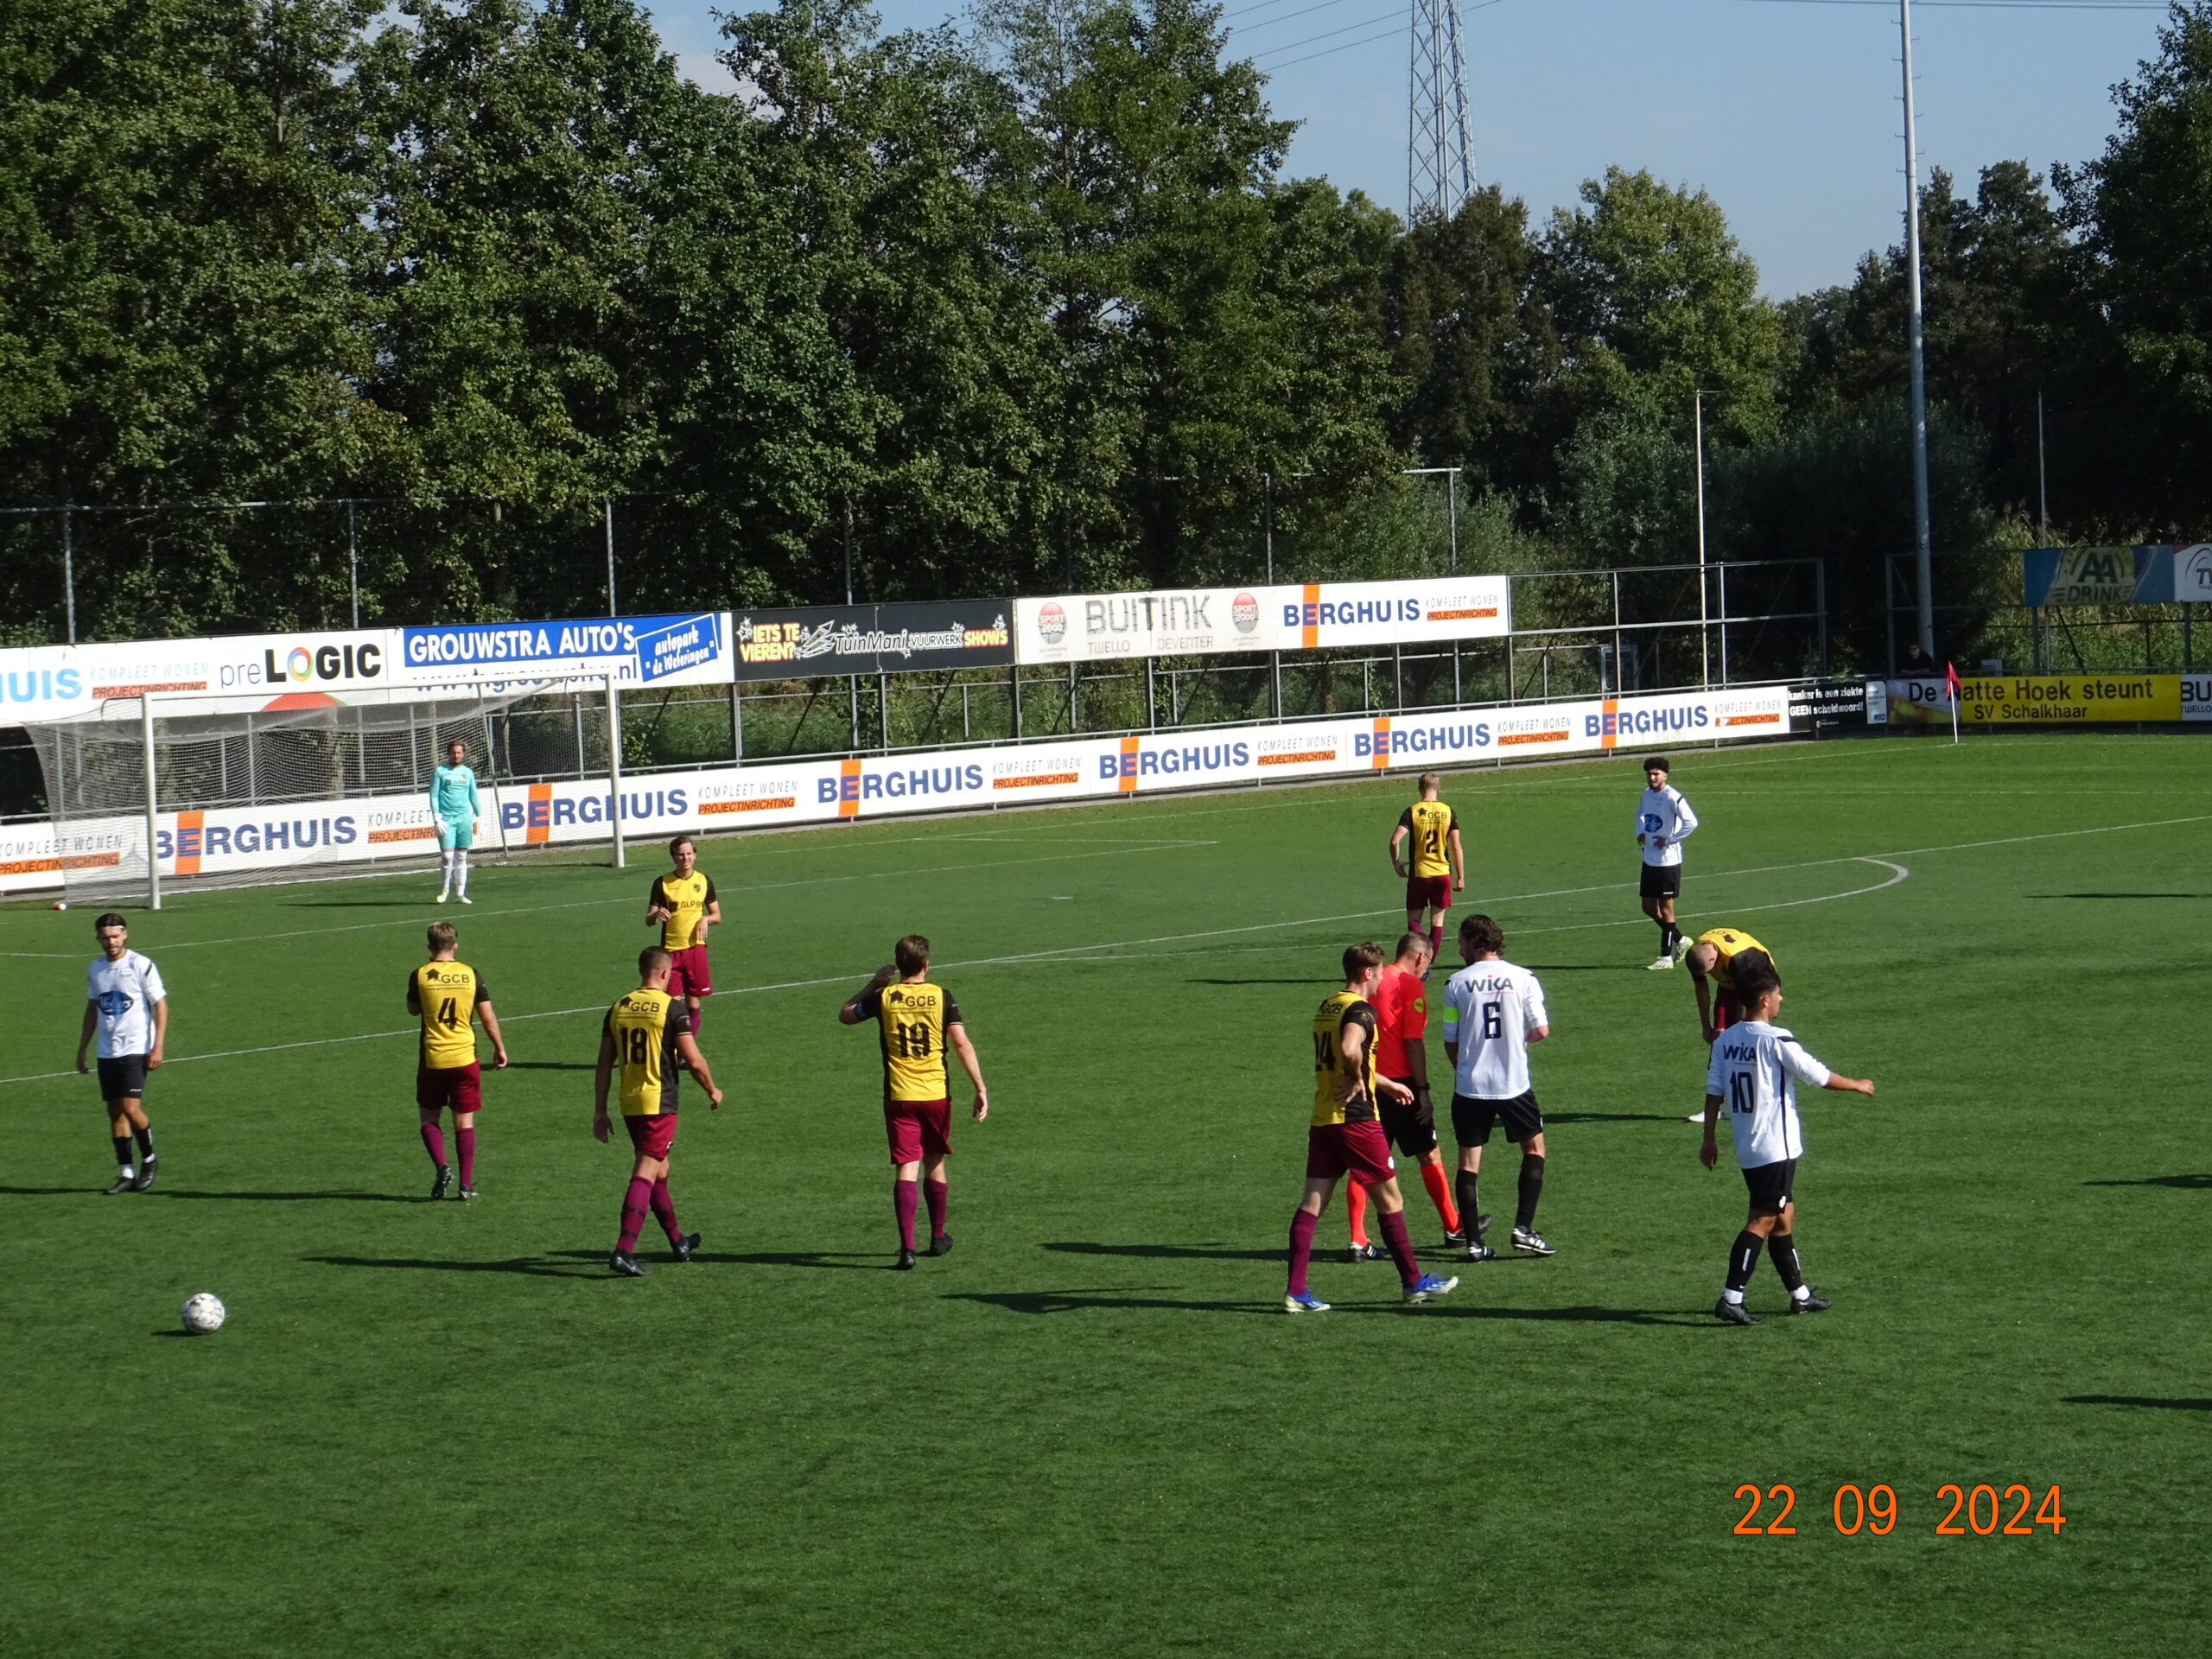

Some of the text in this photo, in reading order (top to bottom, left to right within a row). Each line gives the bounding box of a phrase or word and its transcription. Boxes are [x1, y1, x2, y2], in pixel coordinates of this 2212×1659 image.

[2076, 552, 2117, 583] AA
[1427, 594, 1498, 607] KOMPLEET WONEN
[2067, 585, 2122, 602] DRINK
[1085, 594, 1212, 635] BUITINK
[1233, 604, 1257, 614] SPORT
[1236, 613, 1256, 622] 2000
[1283, 598, 1421, 627] BERGHUIS
[1427, 607, 1497, 621] PROJECTINRICHTING
[1039, 613, 1065, 624] SPORT
[1041, 622, 1064, 632] 2000
[655, 624, 699, 656] autopark
[753, 622, 800, 644] IETS TE
[836, 629, 1008, 654] TuinMani VUURWERK SHOWS
[410, 622, 635, 663] GROUWSTRA AUTO'S
[1087, 639, 1130, 654] TWELLO
[1158, 636, 1214, 650] DEVENTER
[739, 641, 796, 663] VIEREN?
[90, 662, 209, 681] KOMPLEET WONEN
[0, 668, 82, 703] UIS
[1788, 686, 1864, 701] kanker is een ziekte
[1908, 682, 1937, 702] De
[2016, 679, 2072, 701] Hoek
[2082, 678, 2153, 699] steunt
[2180, 681, 2212, 702] BU
[1714, 700, 1782, 714] KOMPLEET WONEN
[1789, 704, 1812, 716] GEEN
[1974, 703, 2088, 720] SV Schalkhaar
[1497, 717, 1571, 733] KOMPLEET WONEN
[1585, 705, 1708, 737] BERGHUIS
[1257, 735, 1338, 752] KOMPLEET WONEN
[1354, 722, 1491, 757] BERGHUIS
[1497, 731, 1569, 746] PROJECTINRICHTING
[993, 757, 1082, 774] KOMPLEET WONEN
[1099, 741, 1249, 779] BERGHUIS
[1257, 750, 1336, 766] PROJECTINRICHTING
[698, 780, 798, 799] KOMPLEET WONEN
[817, 764, 984, 804] BERGHUIS
[993, 772, 1078, 789] PROJECTINRICHTING
[502, 789, 689, 830] BERGHUIS
[698, 797, 795, 815] PROJECTINRICHTING
[1427, 810, 1447, 820] GCB
[367, 810, 431, 828] KOMPLEET
[74, 835, 123, 851] WONEN
[1425, 830, 1439, 854] 2
[441, 974, 470, 983] GCB
[631, 1001, 660, 1013] GCB
[905, 995, 936, 1007] GCB
[1322, 1003, 1344, 1014] GCB
[438, 996, 458, 1030] 4
[1483, 1001, 1502, 1039] 6
[620, 1027, 648, 1065] 18
[897, 1022, 931, 1058] 19
[1730, 1071, 1754, 1114] 10
